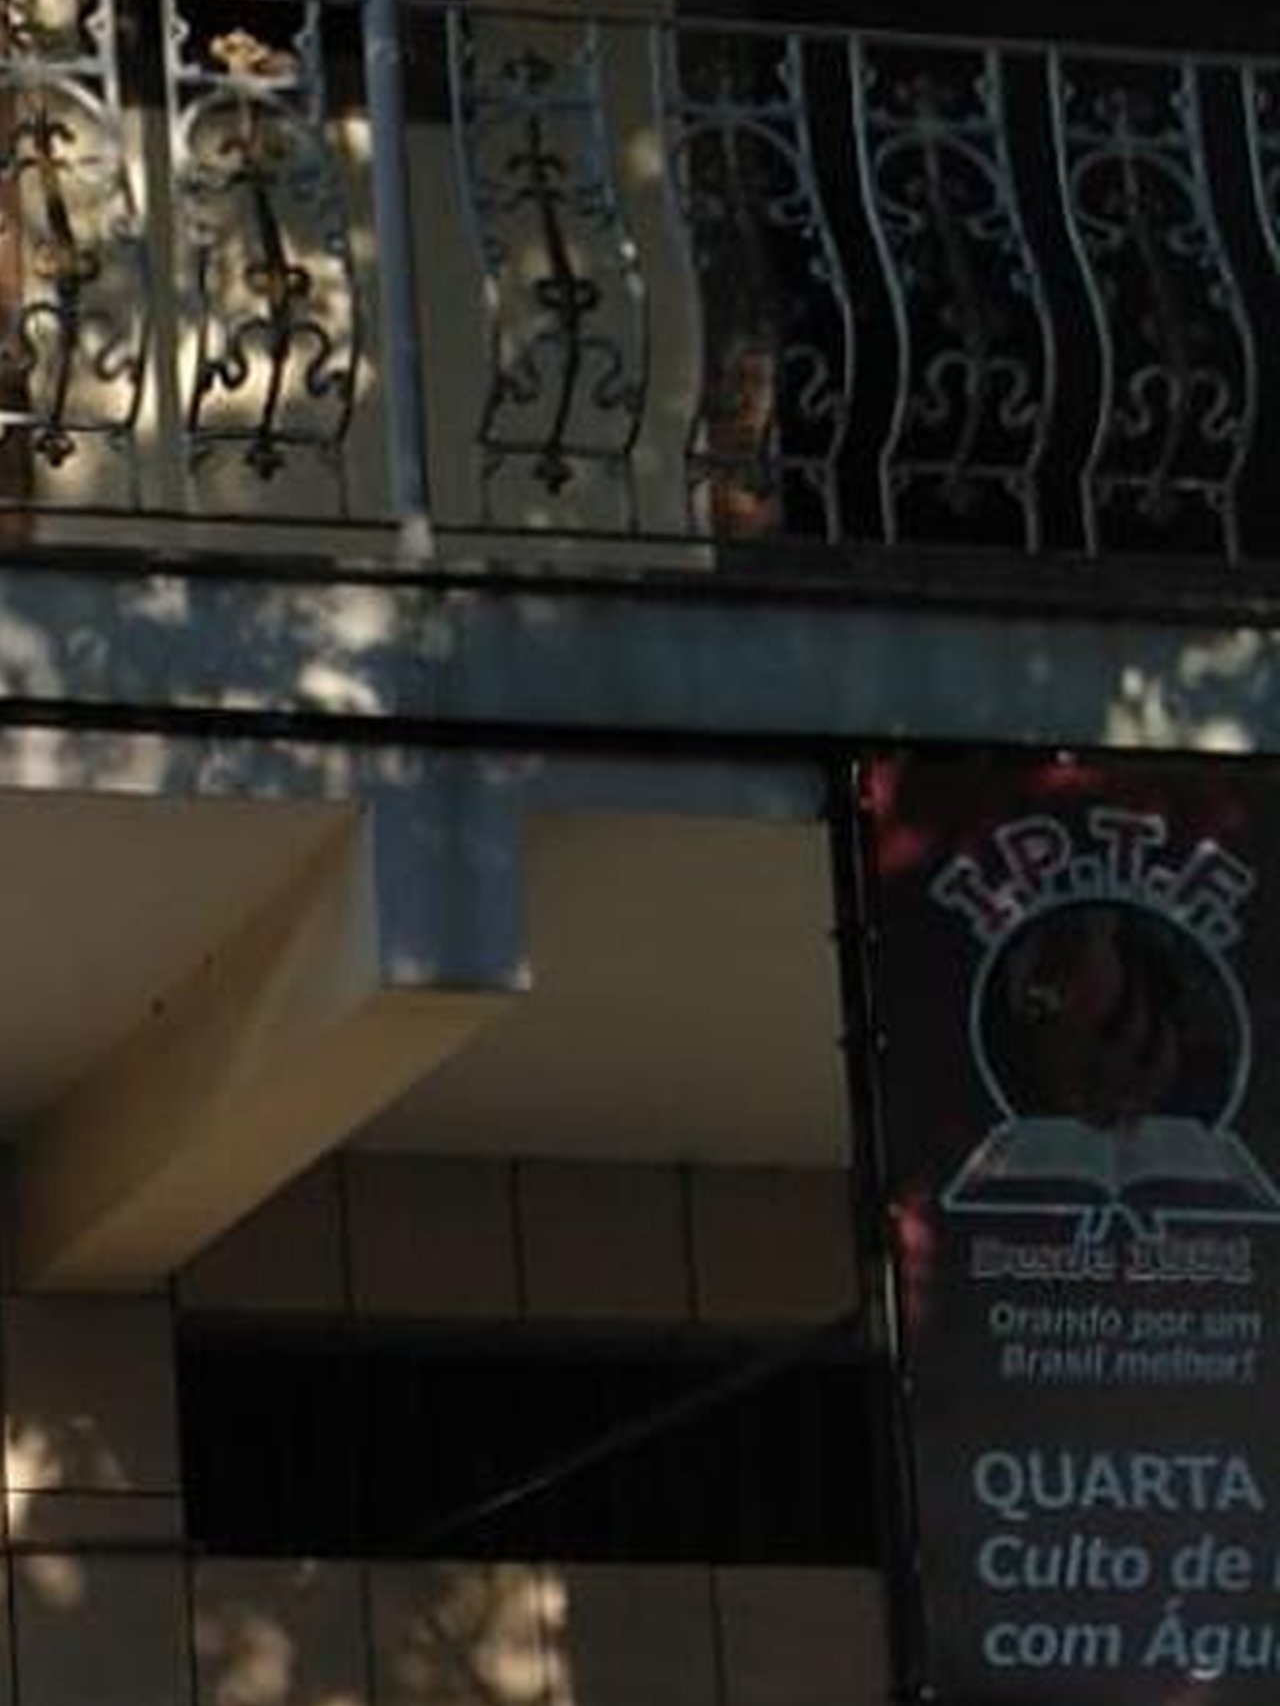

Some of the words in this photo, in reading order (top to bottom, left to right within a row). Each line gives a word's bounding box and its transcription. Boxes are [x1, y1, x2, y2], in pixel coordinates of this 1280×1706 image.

[972, 1449, 1266, 1521] QUARTA
[977, 1533, 1153, 1591] Culto
[1170, 1533, 1253, 1591] de
[981, 1620, 1124, 1669] com
[1142, 1597, 1280, 1681] Águ
